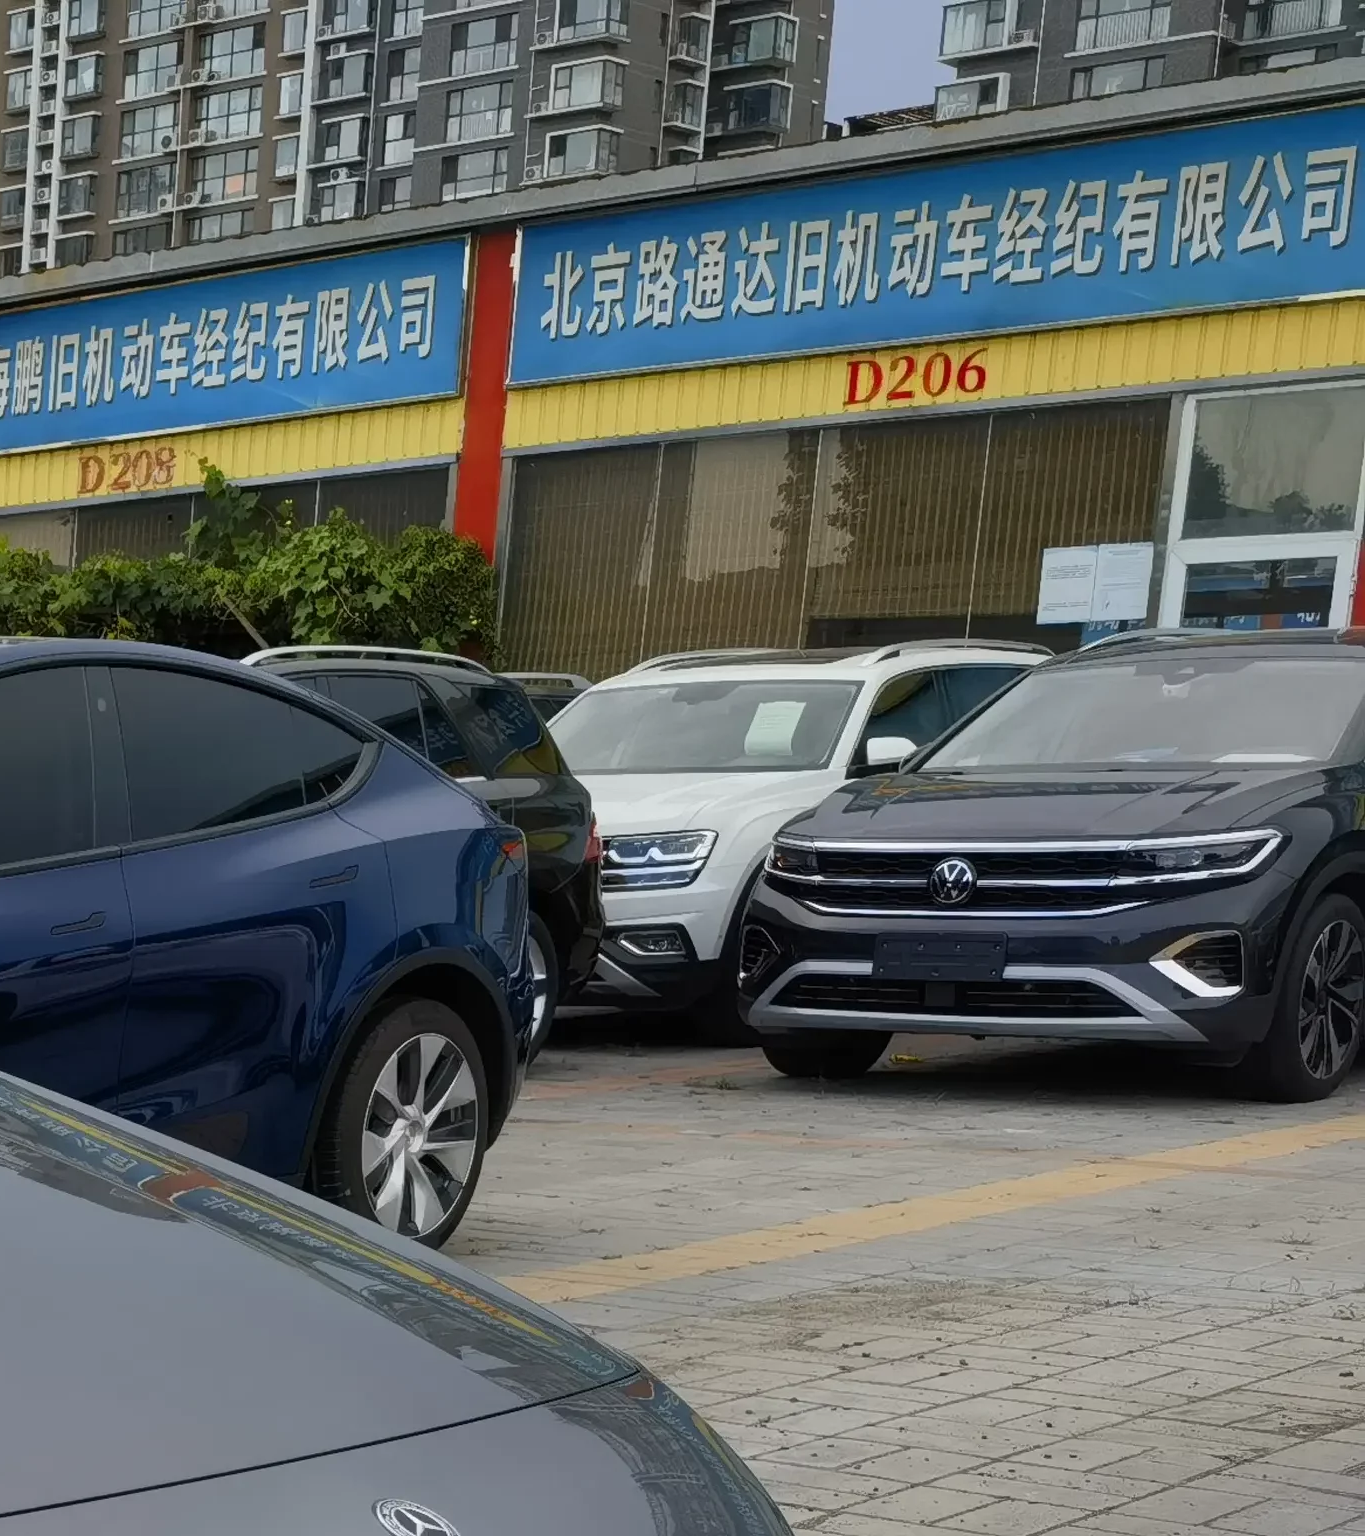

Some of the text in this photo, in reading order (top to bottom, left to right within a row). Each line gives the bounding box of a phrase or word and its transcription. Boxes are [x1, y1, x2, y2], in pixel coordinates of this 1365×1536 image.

[540, 147, 1358, 340] 北京路通达旧机动车经纪有限公司
[845, 350, 988, 405] D206
[76, 446, 177, 495] D208
